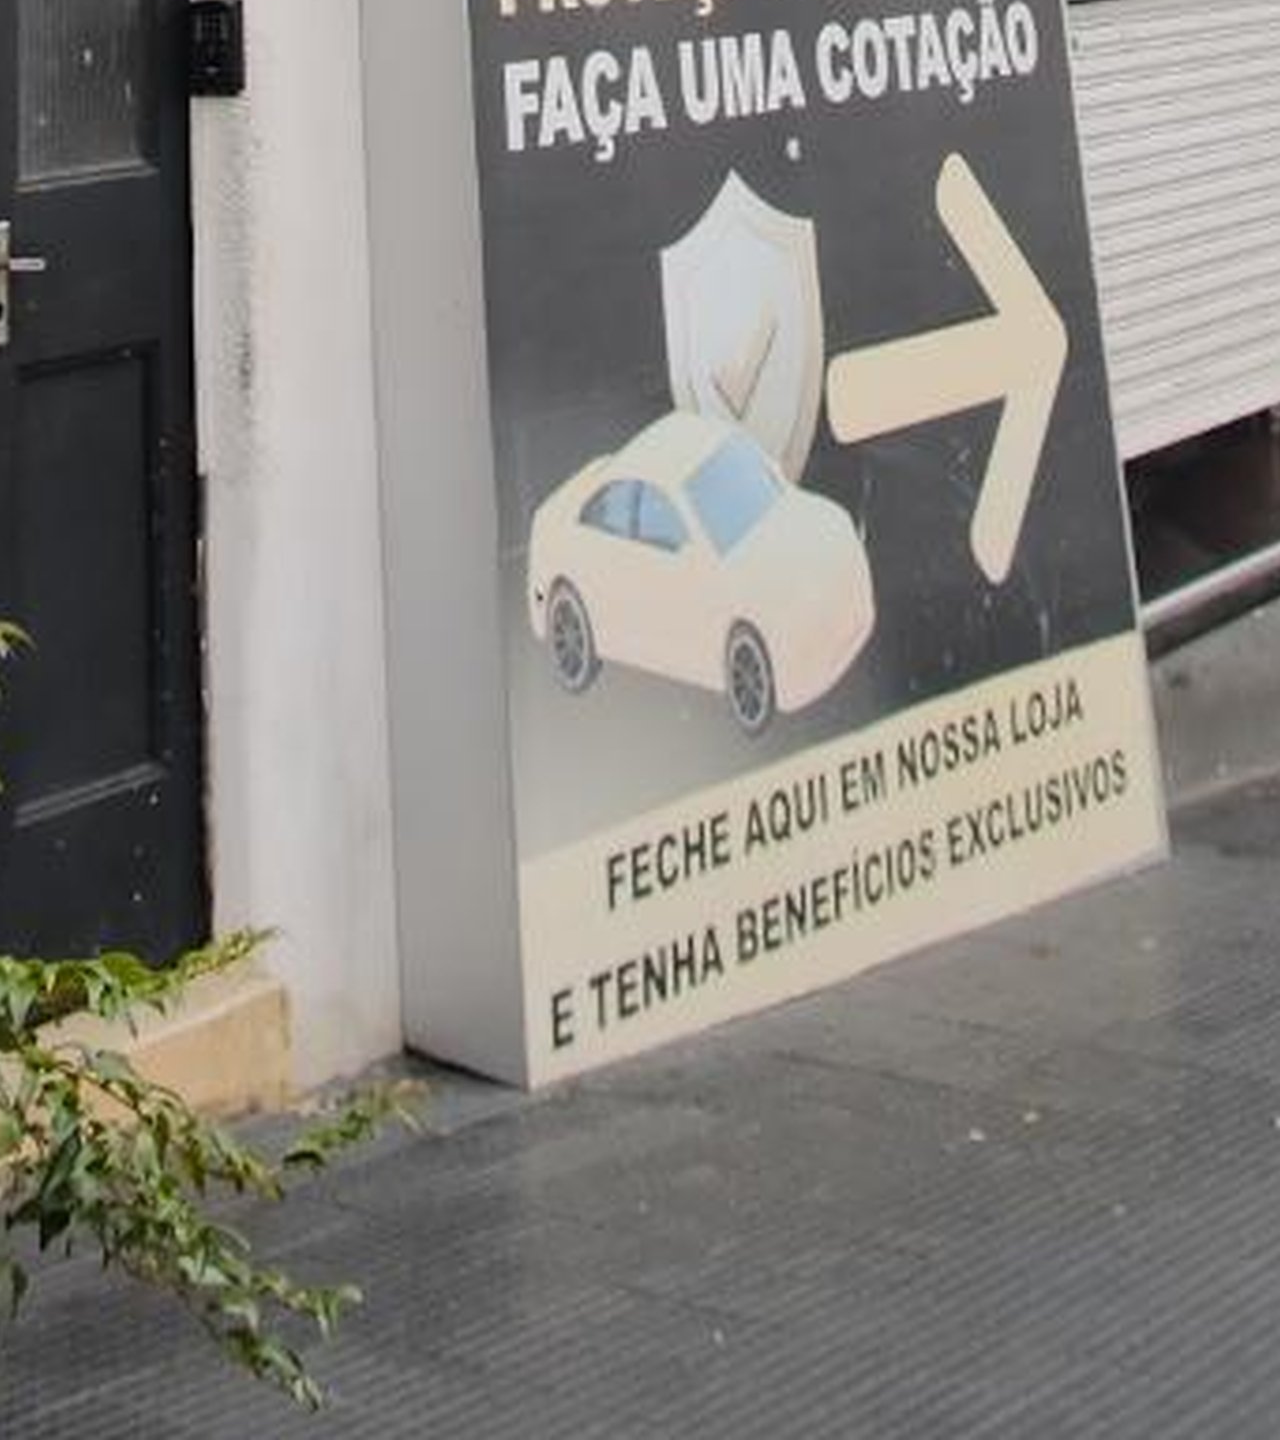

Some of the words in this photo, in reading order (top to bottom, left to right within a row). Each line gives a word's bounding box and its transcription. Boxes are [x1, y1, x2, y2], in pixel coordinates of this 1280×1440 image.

[503, 46, 668, 163] FAÇA
[678, 28, 806, 125] UMA
[550, 985, 574, 1050] E
[588, 926, 725, 1032] TENHA
[735, 829, 938, 965] BENEFÍCIOS
[946, 748, 1127, 867] EXCLUSIVOS
[606, 812, 733, 912] FECHE
[743, 774, 831, 861] AQUI
[841, 752, 888, 814] EM
[896, 711, 1002, 789] NOSSA
[1010, 679, 1084, 747] LOJA
